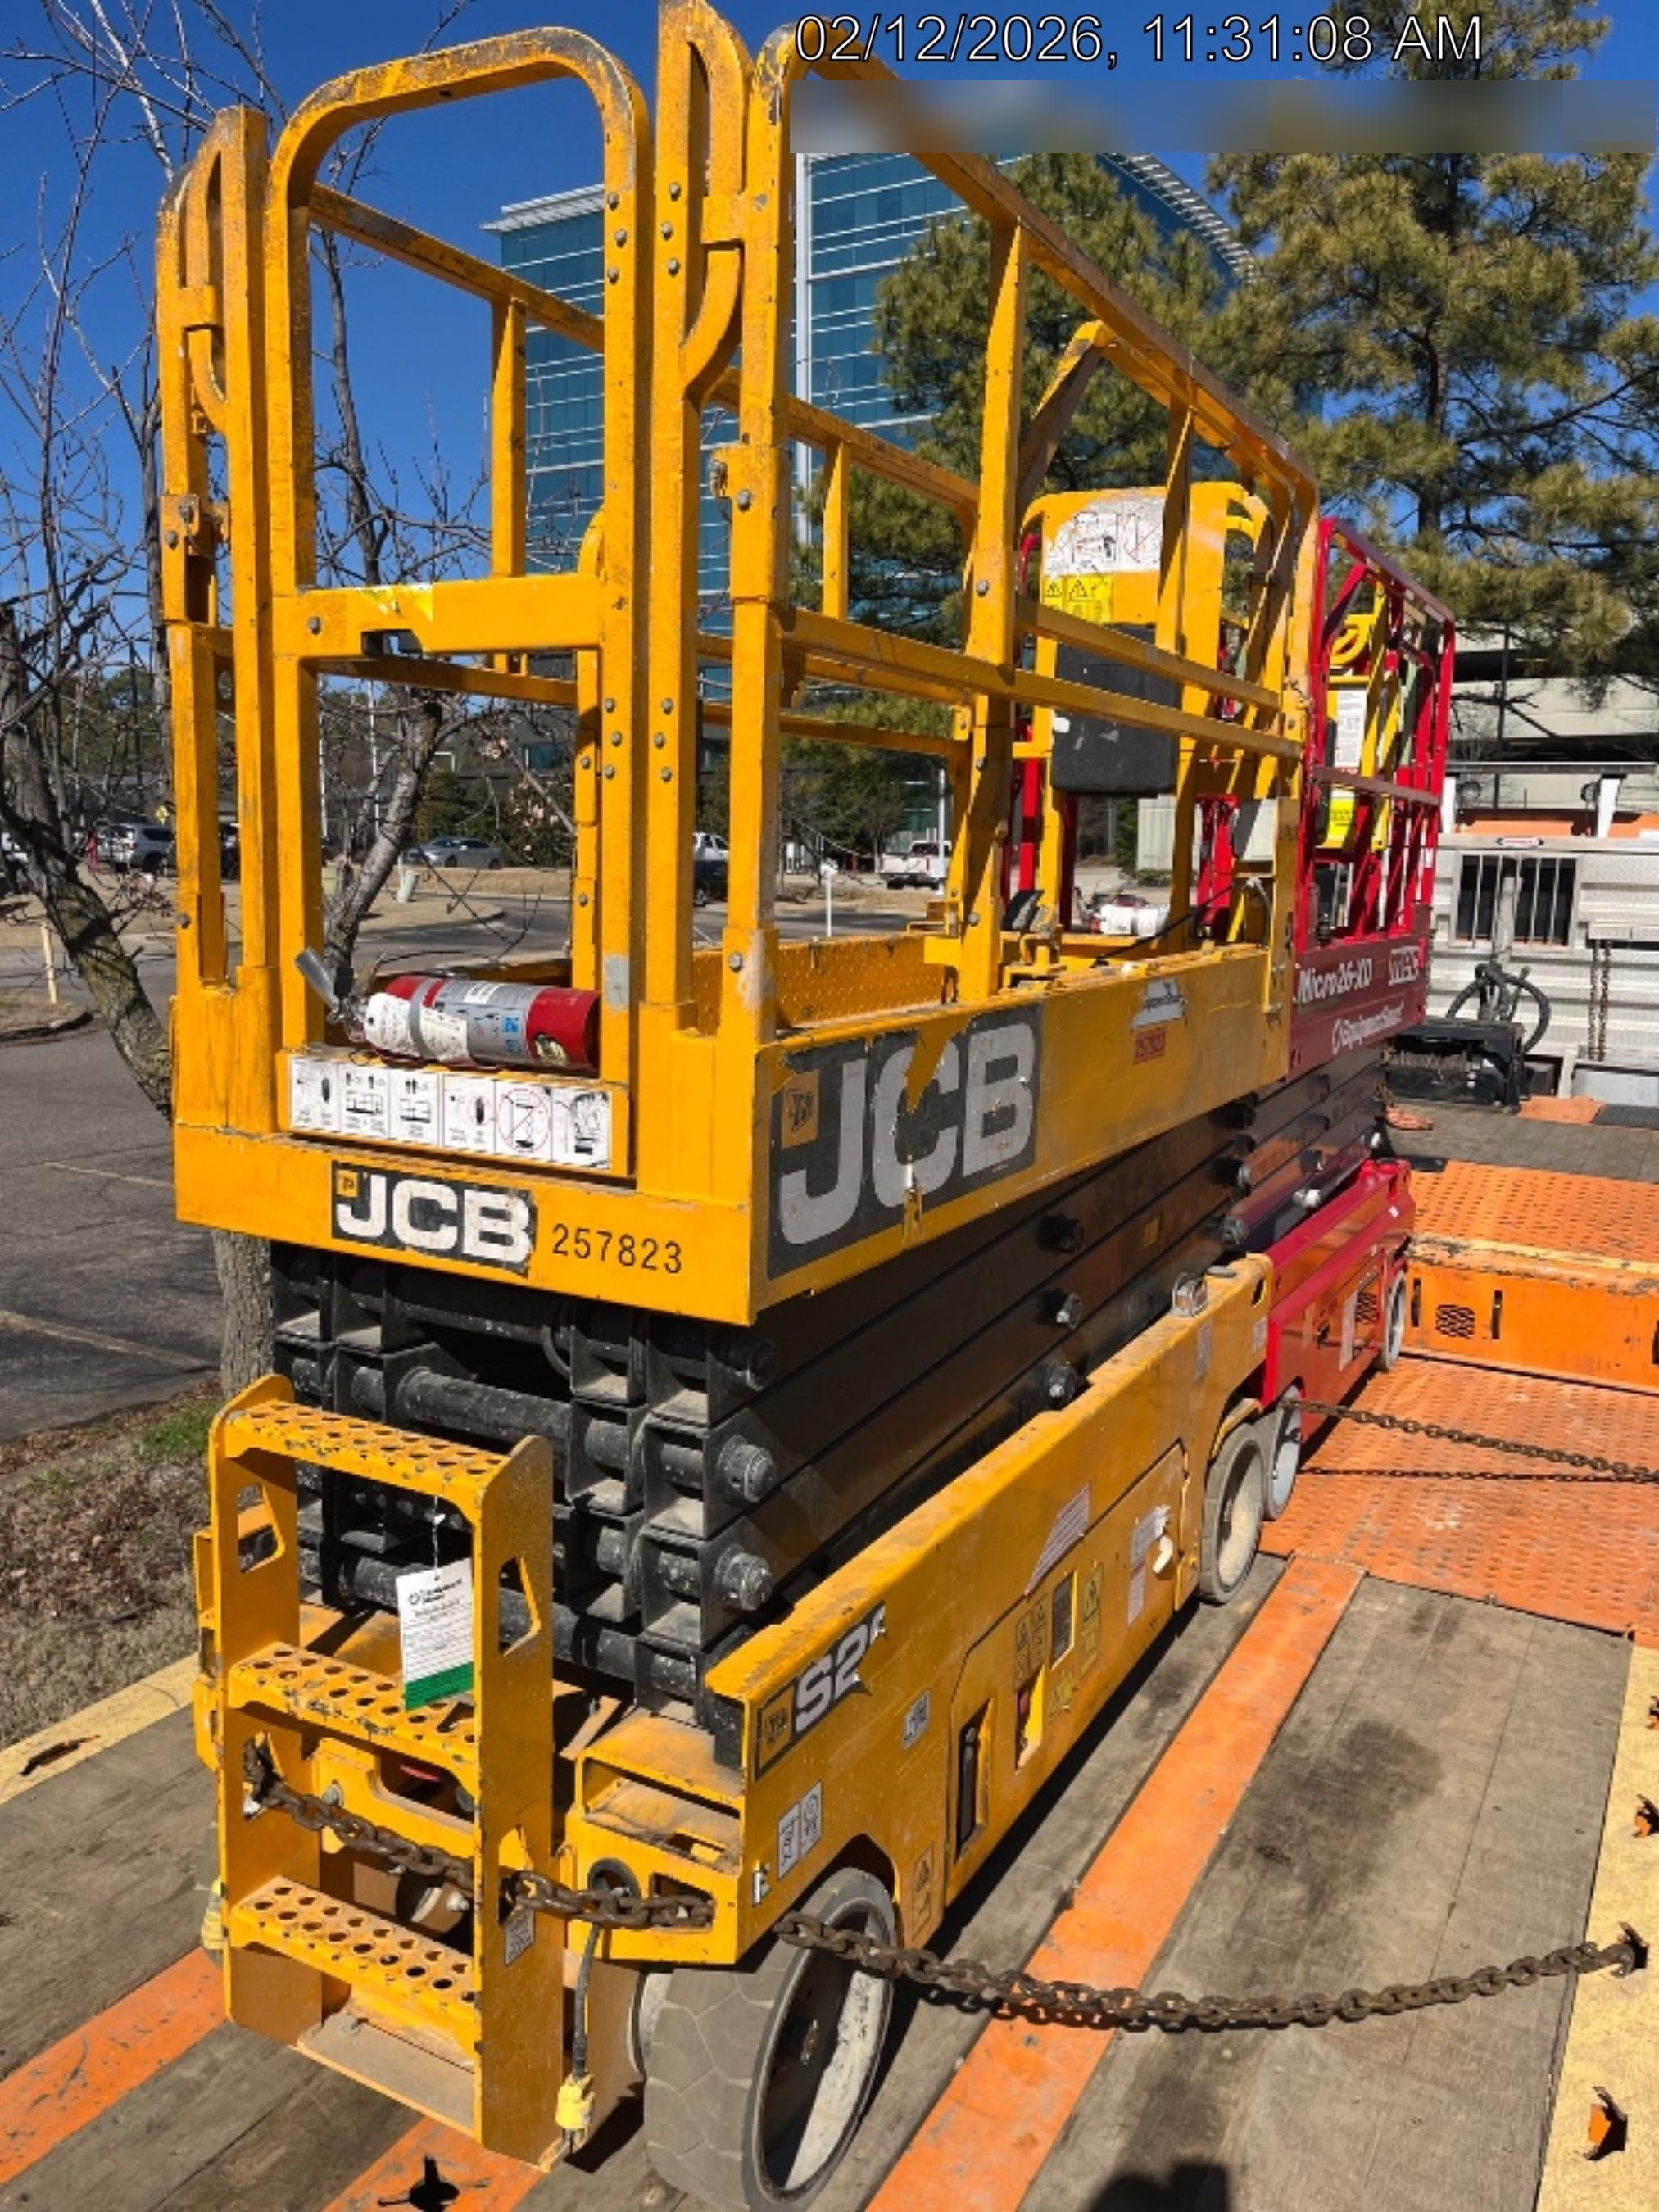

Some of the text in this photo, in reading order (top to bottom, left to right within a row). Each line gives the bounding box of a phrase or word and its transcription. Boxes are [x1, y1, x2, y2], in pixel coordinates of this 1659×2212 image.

[779, 1022, 1036, 1245] JCB
[337, 1172, 533, 1266] JCB
[551, 1222, 683, 1275] 257823
